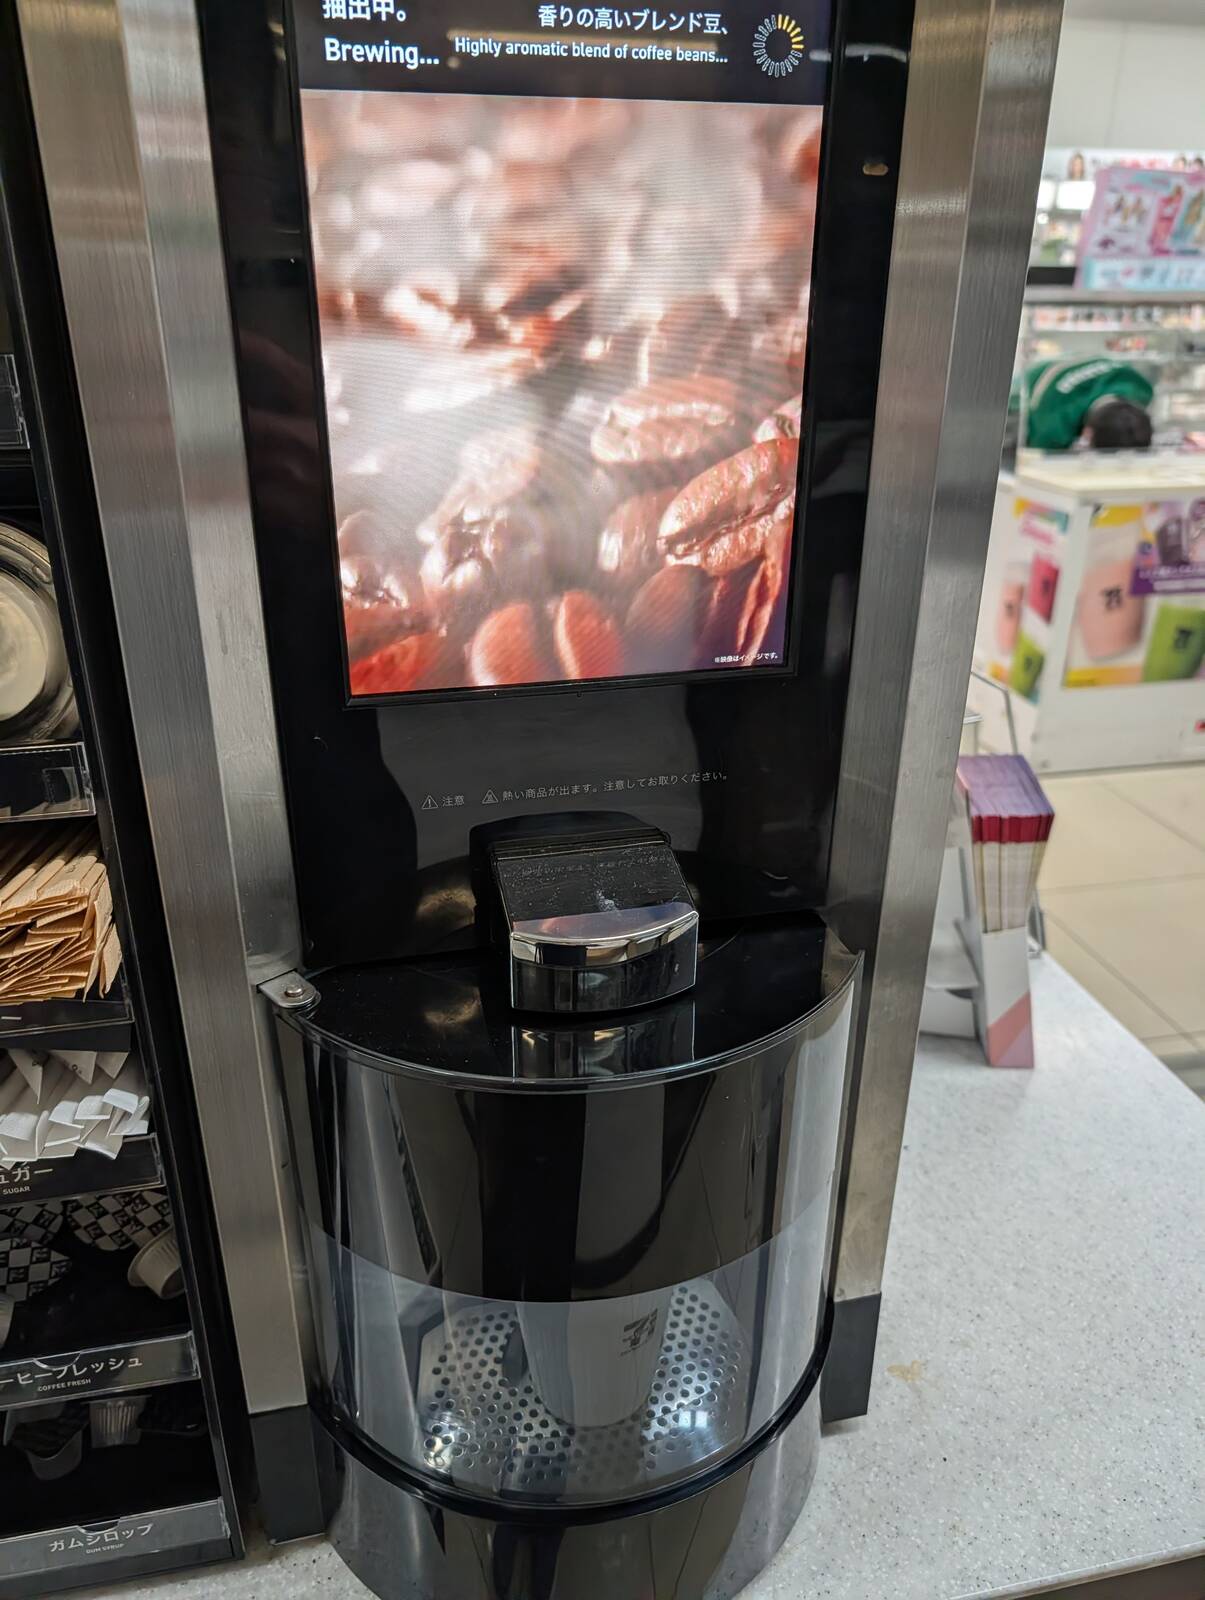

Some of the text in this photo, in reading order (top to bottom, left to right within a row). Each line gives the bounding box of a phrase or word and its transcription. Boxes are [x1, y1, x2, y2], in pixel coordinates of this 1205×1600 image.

[322, 0, 407, 22] 抽出中。
[538, 5, 728, 35] 香りの高いブレンド豆、
[324, 37, 440, 70] Brewing...
[455, 37, 728, 63] Highly aromatic blend of coffee beans...
[441, 794, 465, 807] 注意
[2, 1186, 31, 1195] SUGAR
[37, 1378, 92, 1392] COFFEE FRESH
